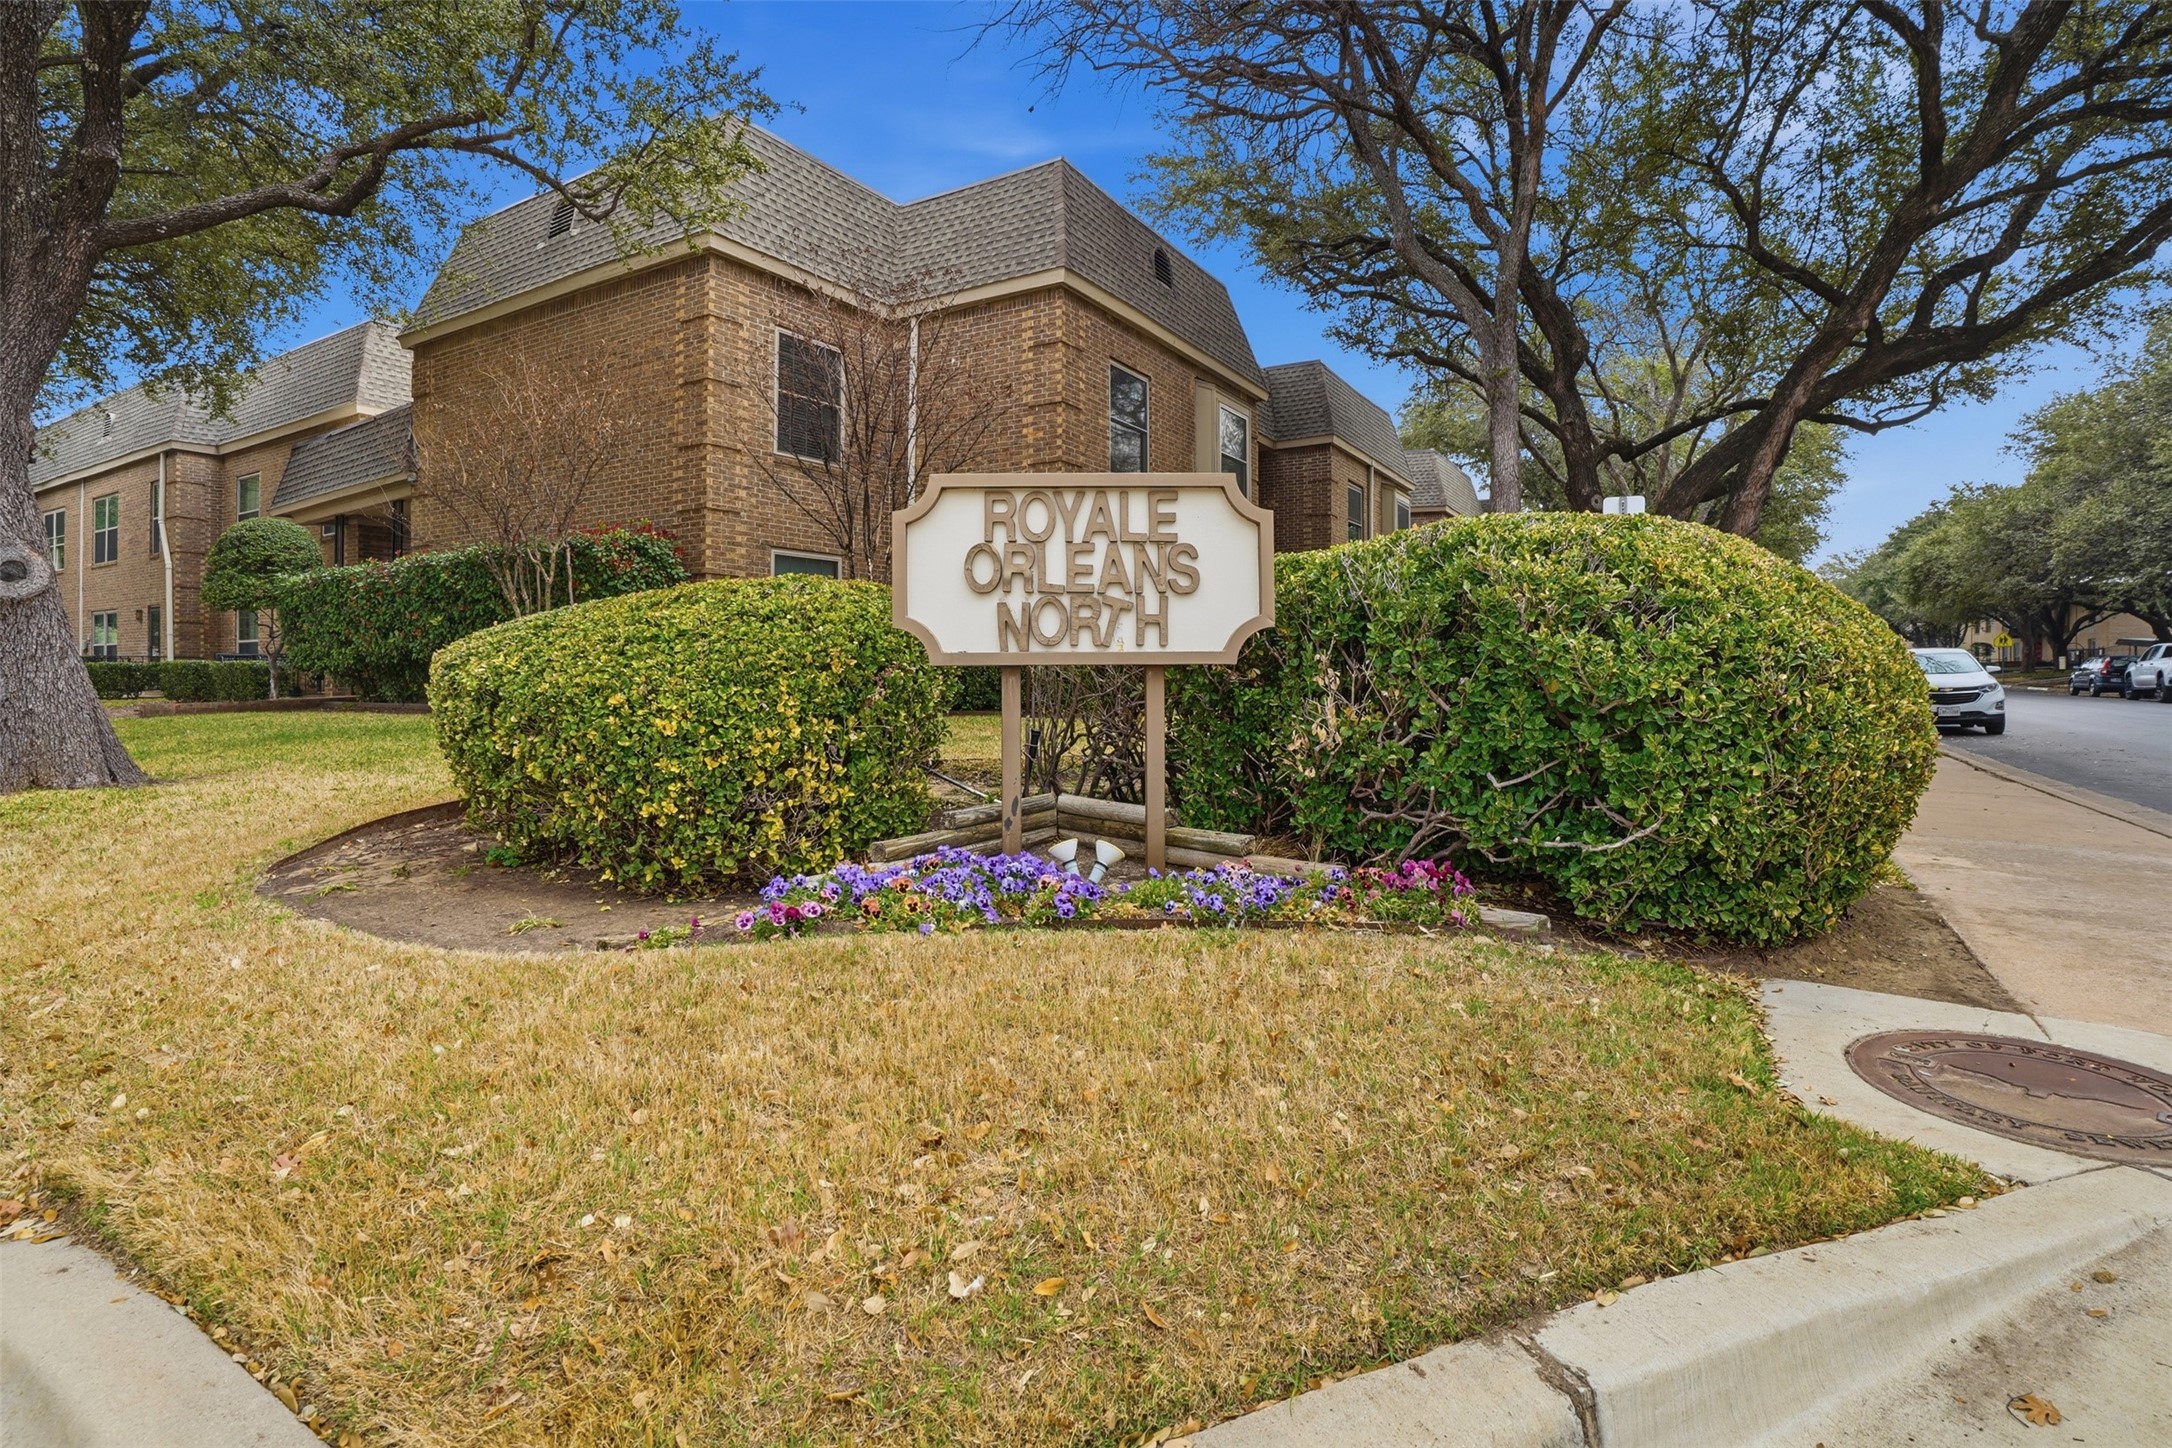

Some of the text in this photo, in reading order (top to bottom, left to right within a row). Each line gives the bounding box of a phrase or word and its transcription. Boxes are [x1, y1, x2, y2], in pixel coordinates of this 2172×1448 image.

[984, 490, 1178, 543] ROYALE
[963, 542, 1201, 595] ORLEANS
[996, 594, 1169, 653] NORTH
